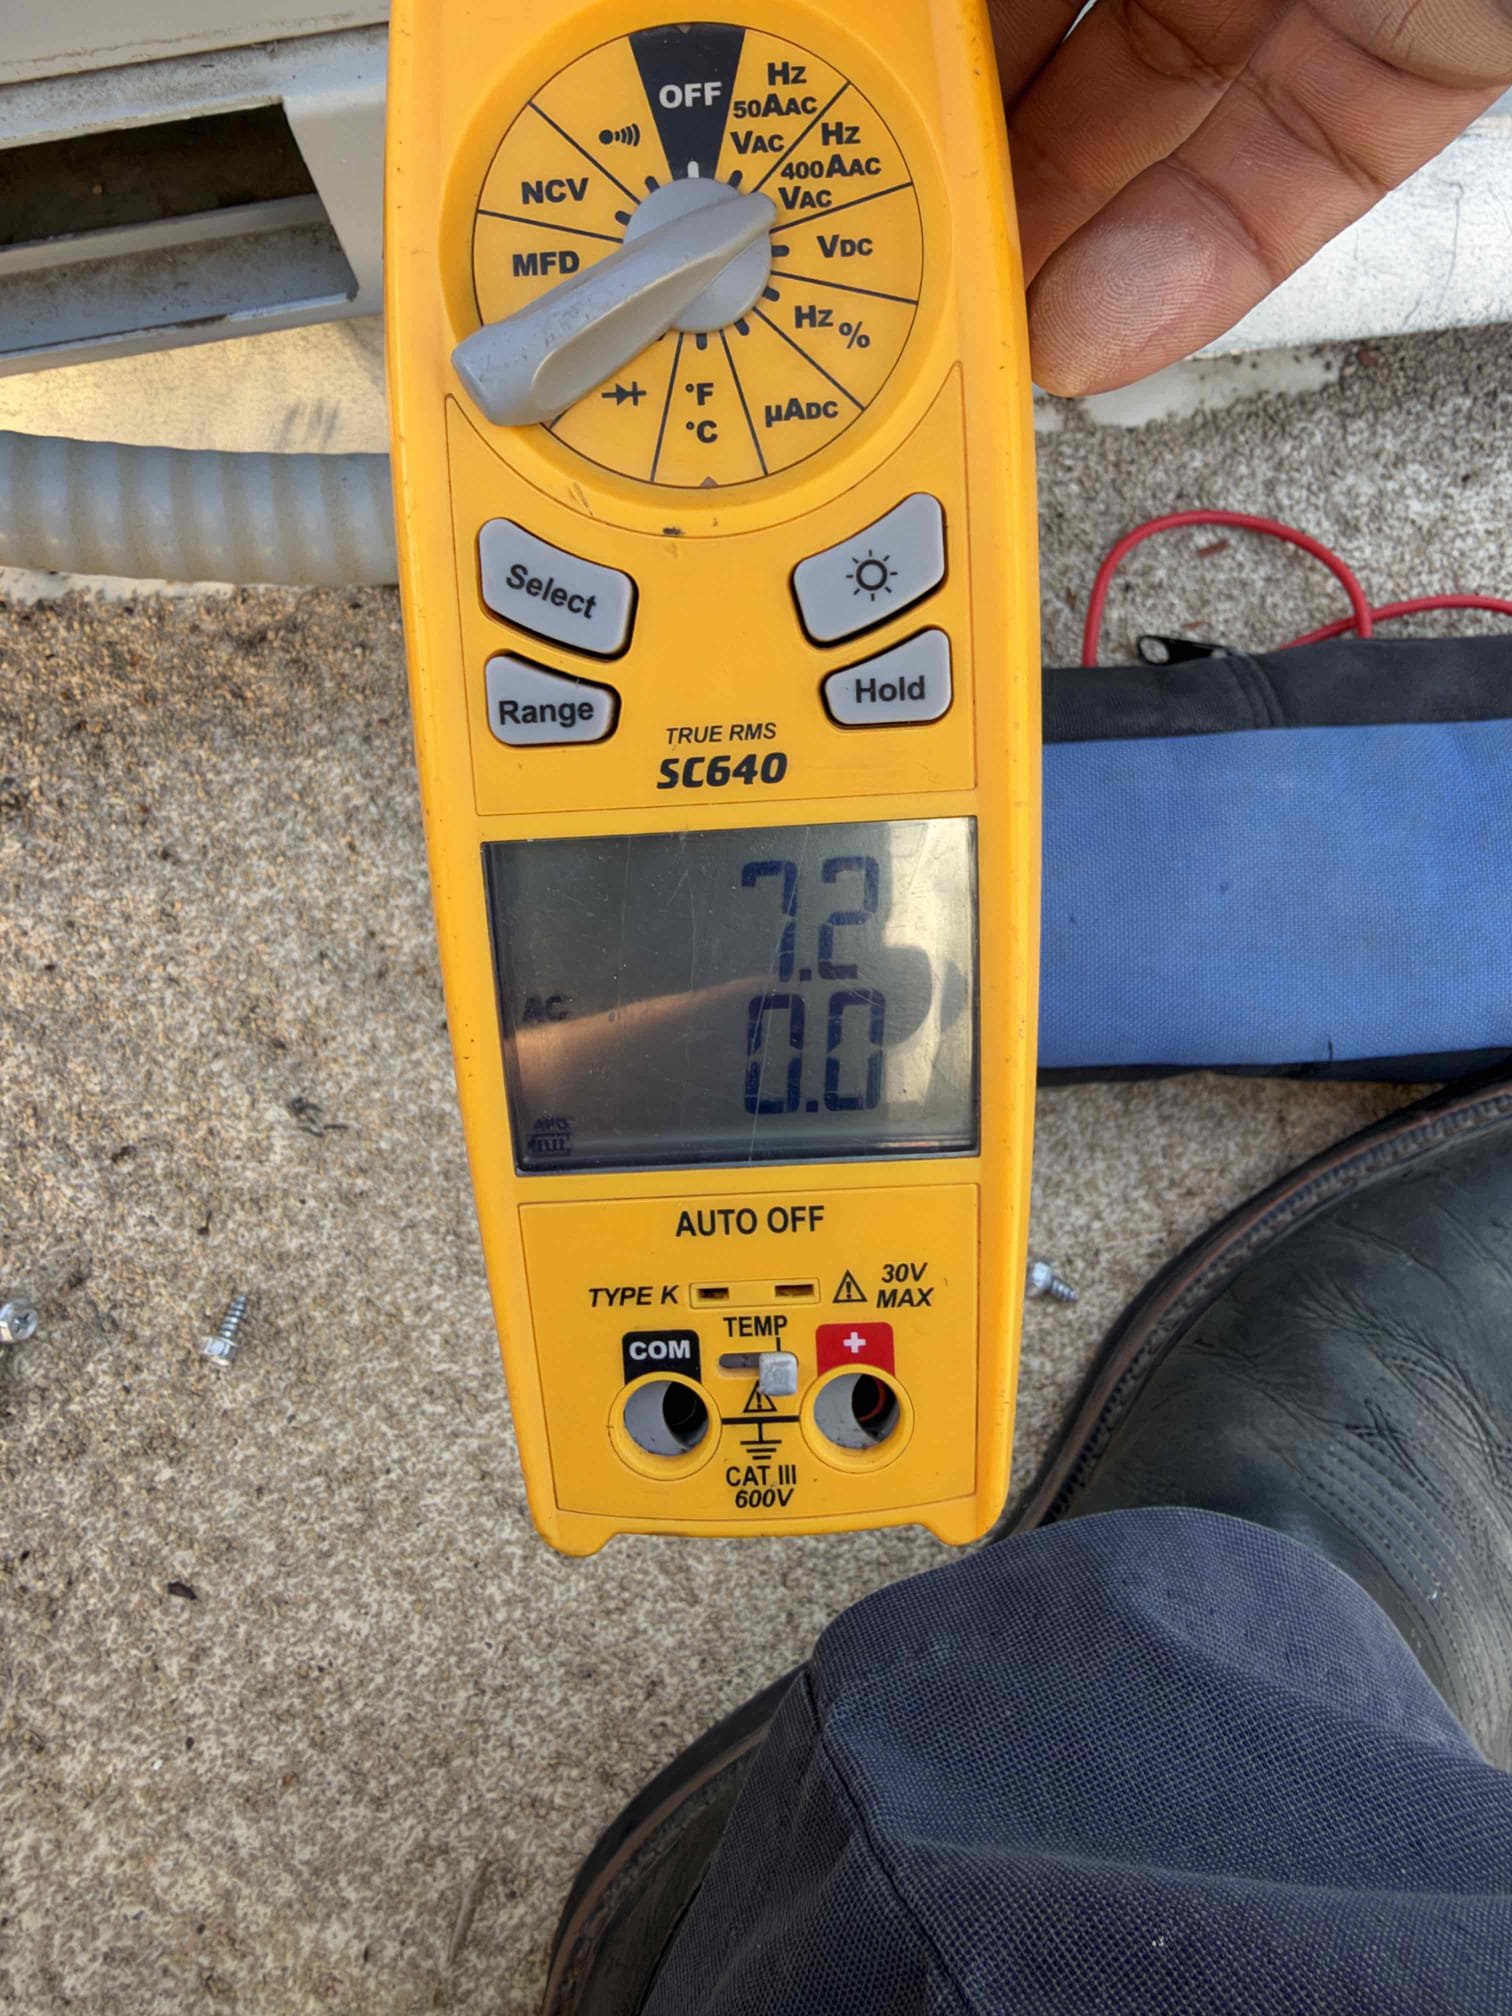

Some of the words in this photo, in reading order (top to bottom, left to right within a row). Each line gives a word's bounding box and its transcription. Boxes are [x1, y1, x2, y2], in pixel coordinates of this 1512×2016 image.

[767, 62, 807, 86] Hz
[658, 81, 722, 109] OFF
[821, 121, 861, 146] Hz
[521, 178, 589, 205] NCV
[512, 250, 580, 277] MFD
[794, 305, 834, 329] Hz
[839, 321, 870, 349] %
[505, 564, 596, 620] Select
[855, 676, 926, 703] Hold
[498, 700, 595, 728] Range
[666, 725, 723, 746] TRUE
[729, 722, 777, 741] RMS
[656, 752, 788, 790] SC640
[741, 856, 880, 983] 7.2
[744, 988, 885, 1115] 0.0
[675, 1207, 758, 1238] AUTO
[766, 1205, 825, 1233] OFF
[881, 1262, 929, 1283] 30V
[588, 1287, 653, 1308] TYPE
[660, 1285, 680, 1305] K
[875, 1288, 935, 1309] MAX
[723, 1315, 788, 1338] TEMP
[629, 1340, 691, 1360] COM
[725, 1466, 769, 1487] CAT
[778, 1465, 797, 1485] III
[735, 1489, 794, 1509] 600V
